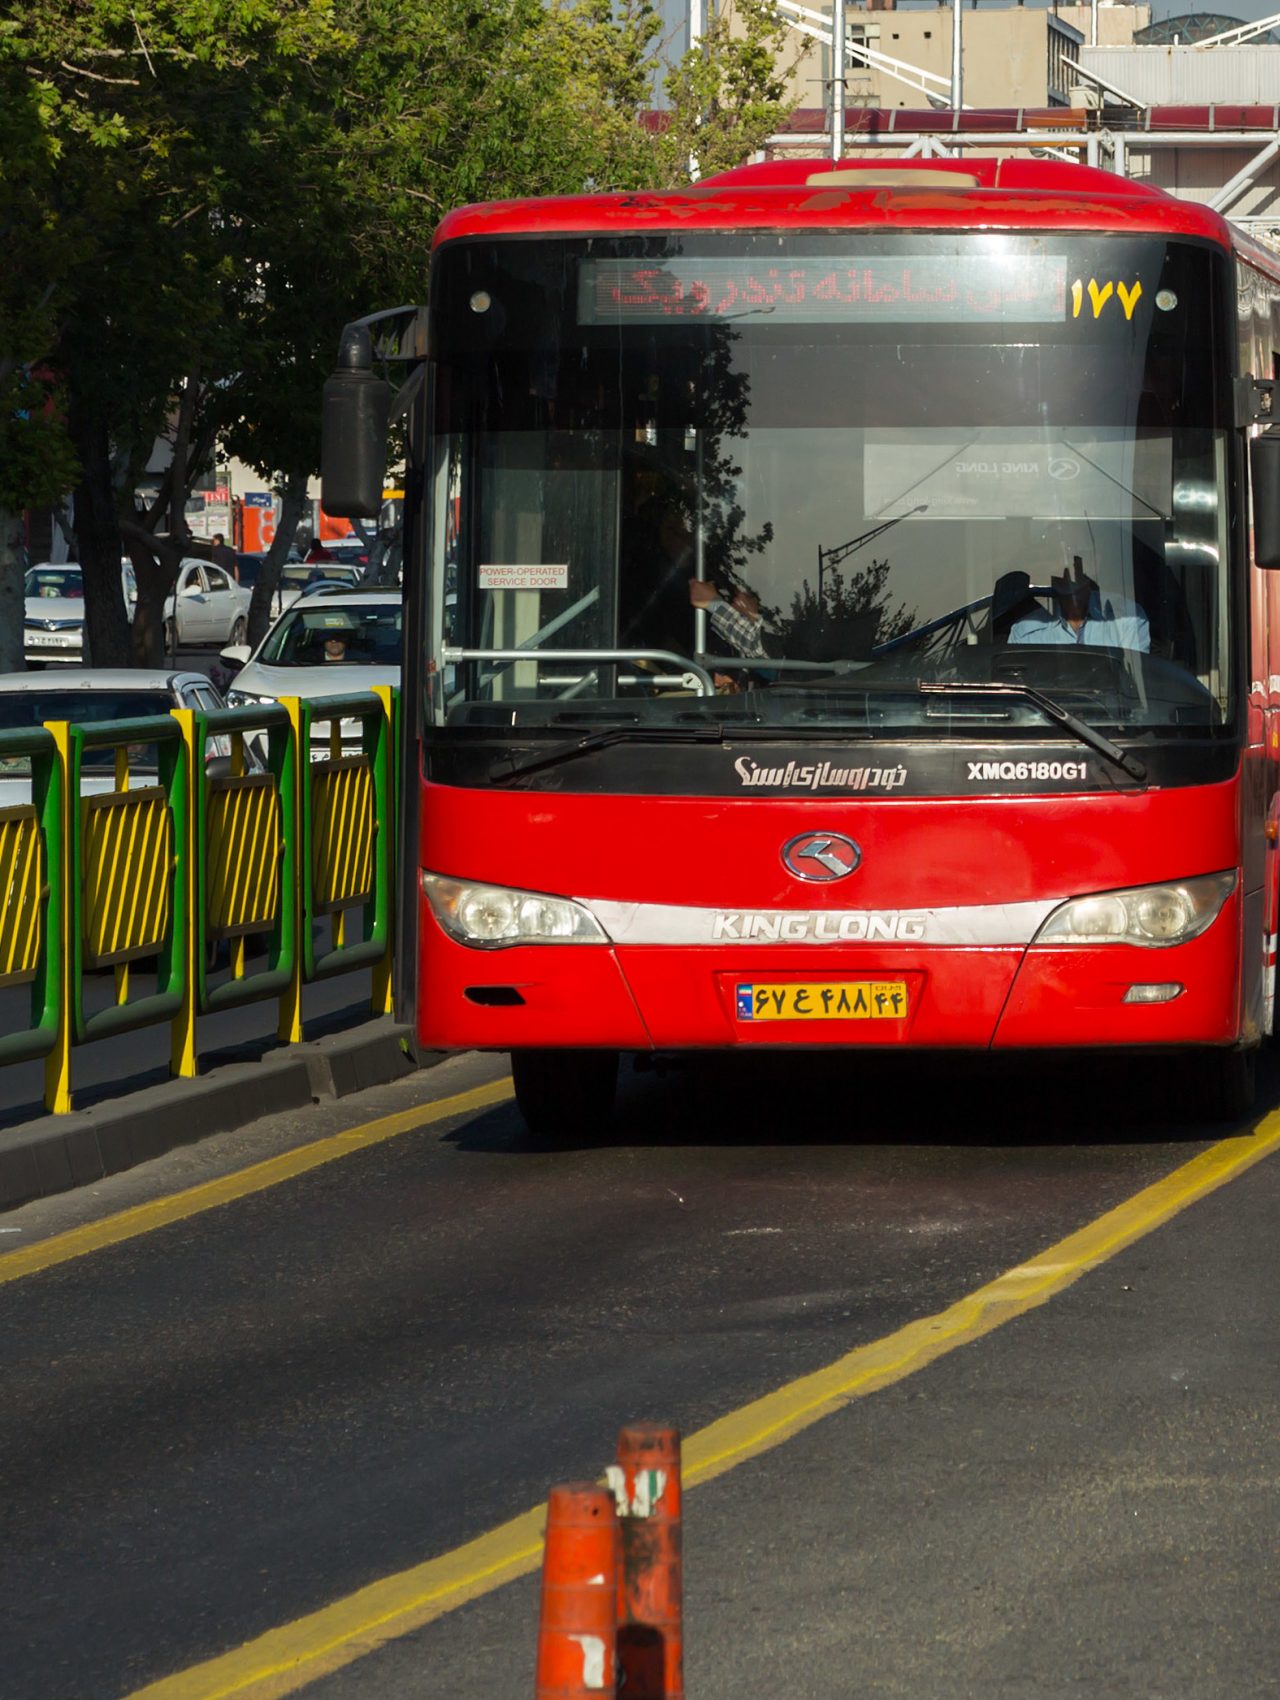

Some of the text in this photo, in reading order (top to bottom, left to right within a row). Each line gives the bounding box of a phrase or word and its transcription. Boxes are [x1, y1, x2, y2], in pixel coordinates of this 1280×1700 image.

[1071, 278, 1142, 320] ۱۷۷
[480, 567, 565, 576] POWER-OPERATED
[487, 577, 558, 586] SERVICE DOOR
[967, 762, 1087, 780] XMQ6180G1
[712, 914, 928, 940] KING LONG
